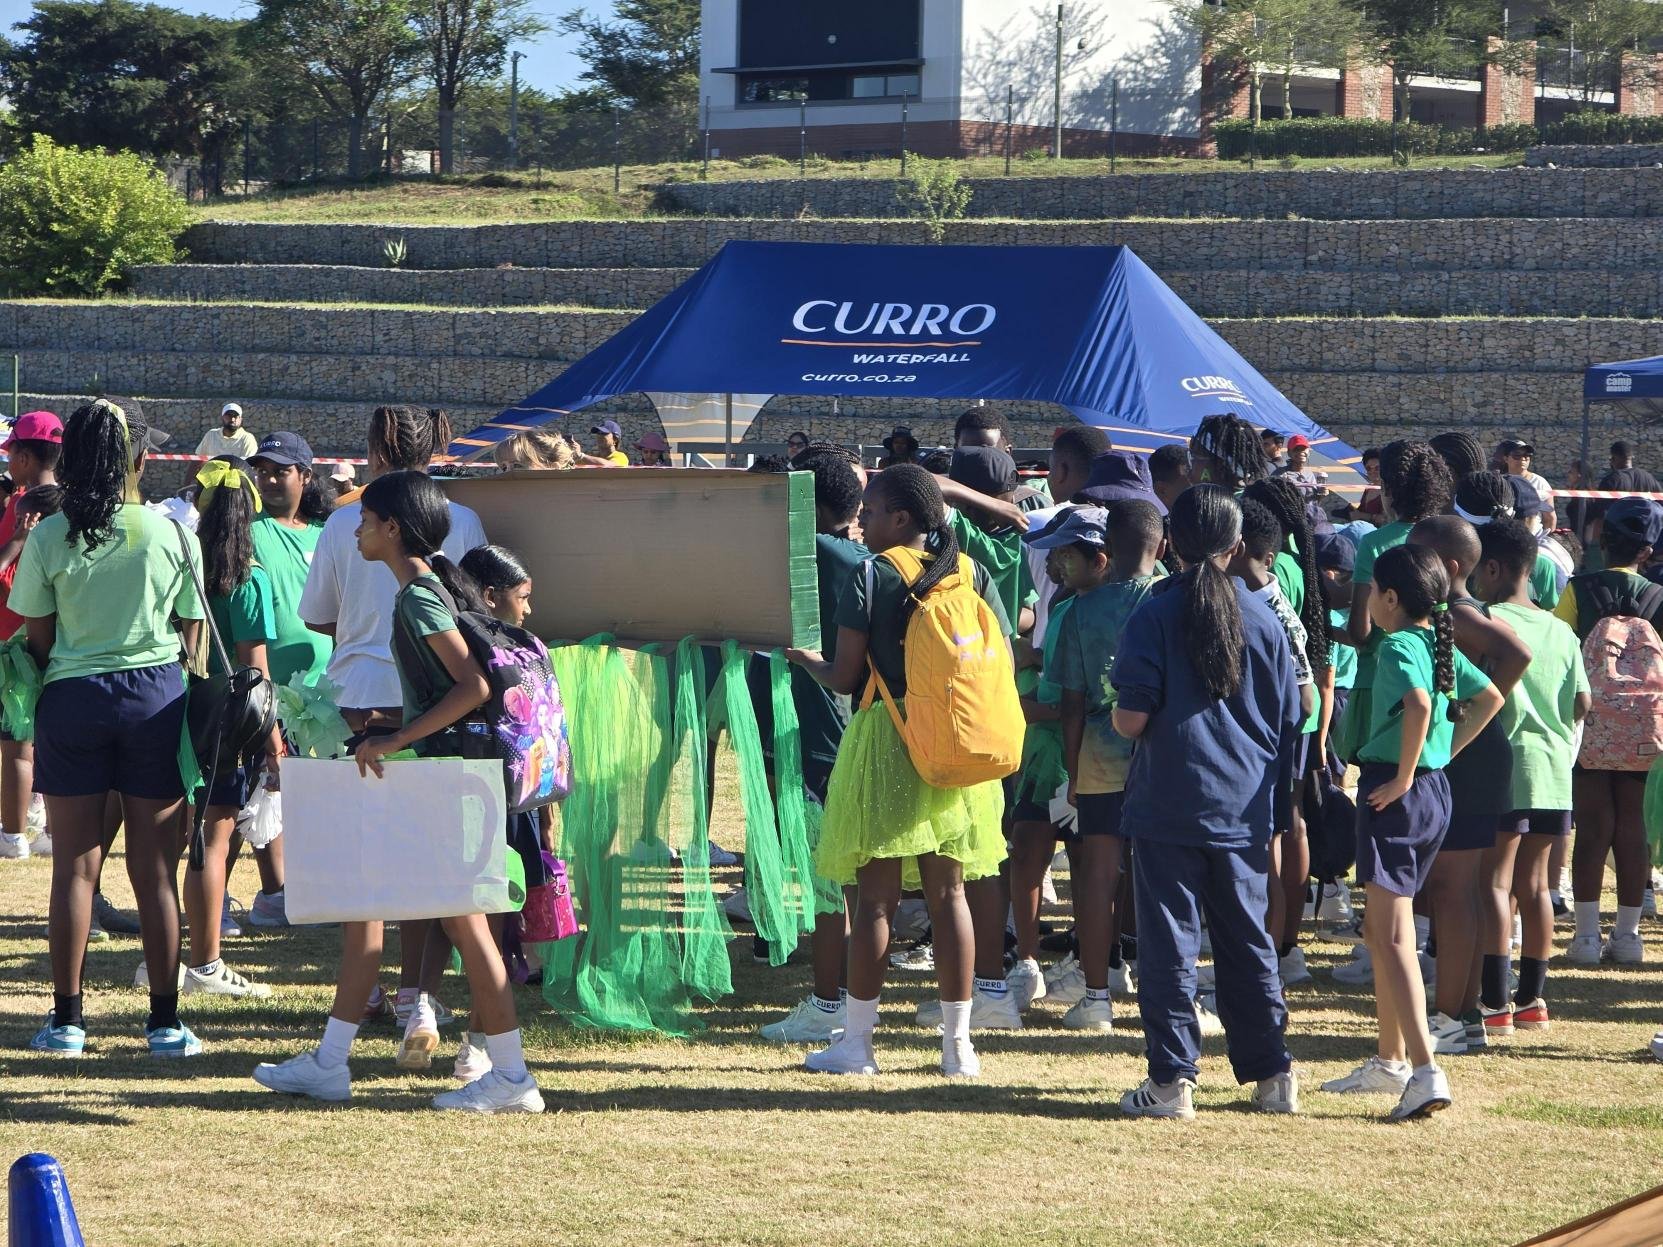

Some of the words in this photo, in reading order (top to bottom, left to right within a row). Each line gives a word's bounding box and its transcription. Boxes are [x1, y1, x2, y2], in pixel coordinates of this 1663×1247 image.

[792, 300, 997, 335] CURRO
[852, 352, 971, 364] WATERFALL
[801, 373, 917, 383] curro.co.za
[1606, 377, 1632, 386] camp
[975, 980, 1002, 989] CURRO
[816, 999, 841, 1010] CURRO
